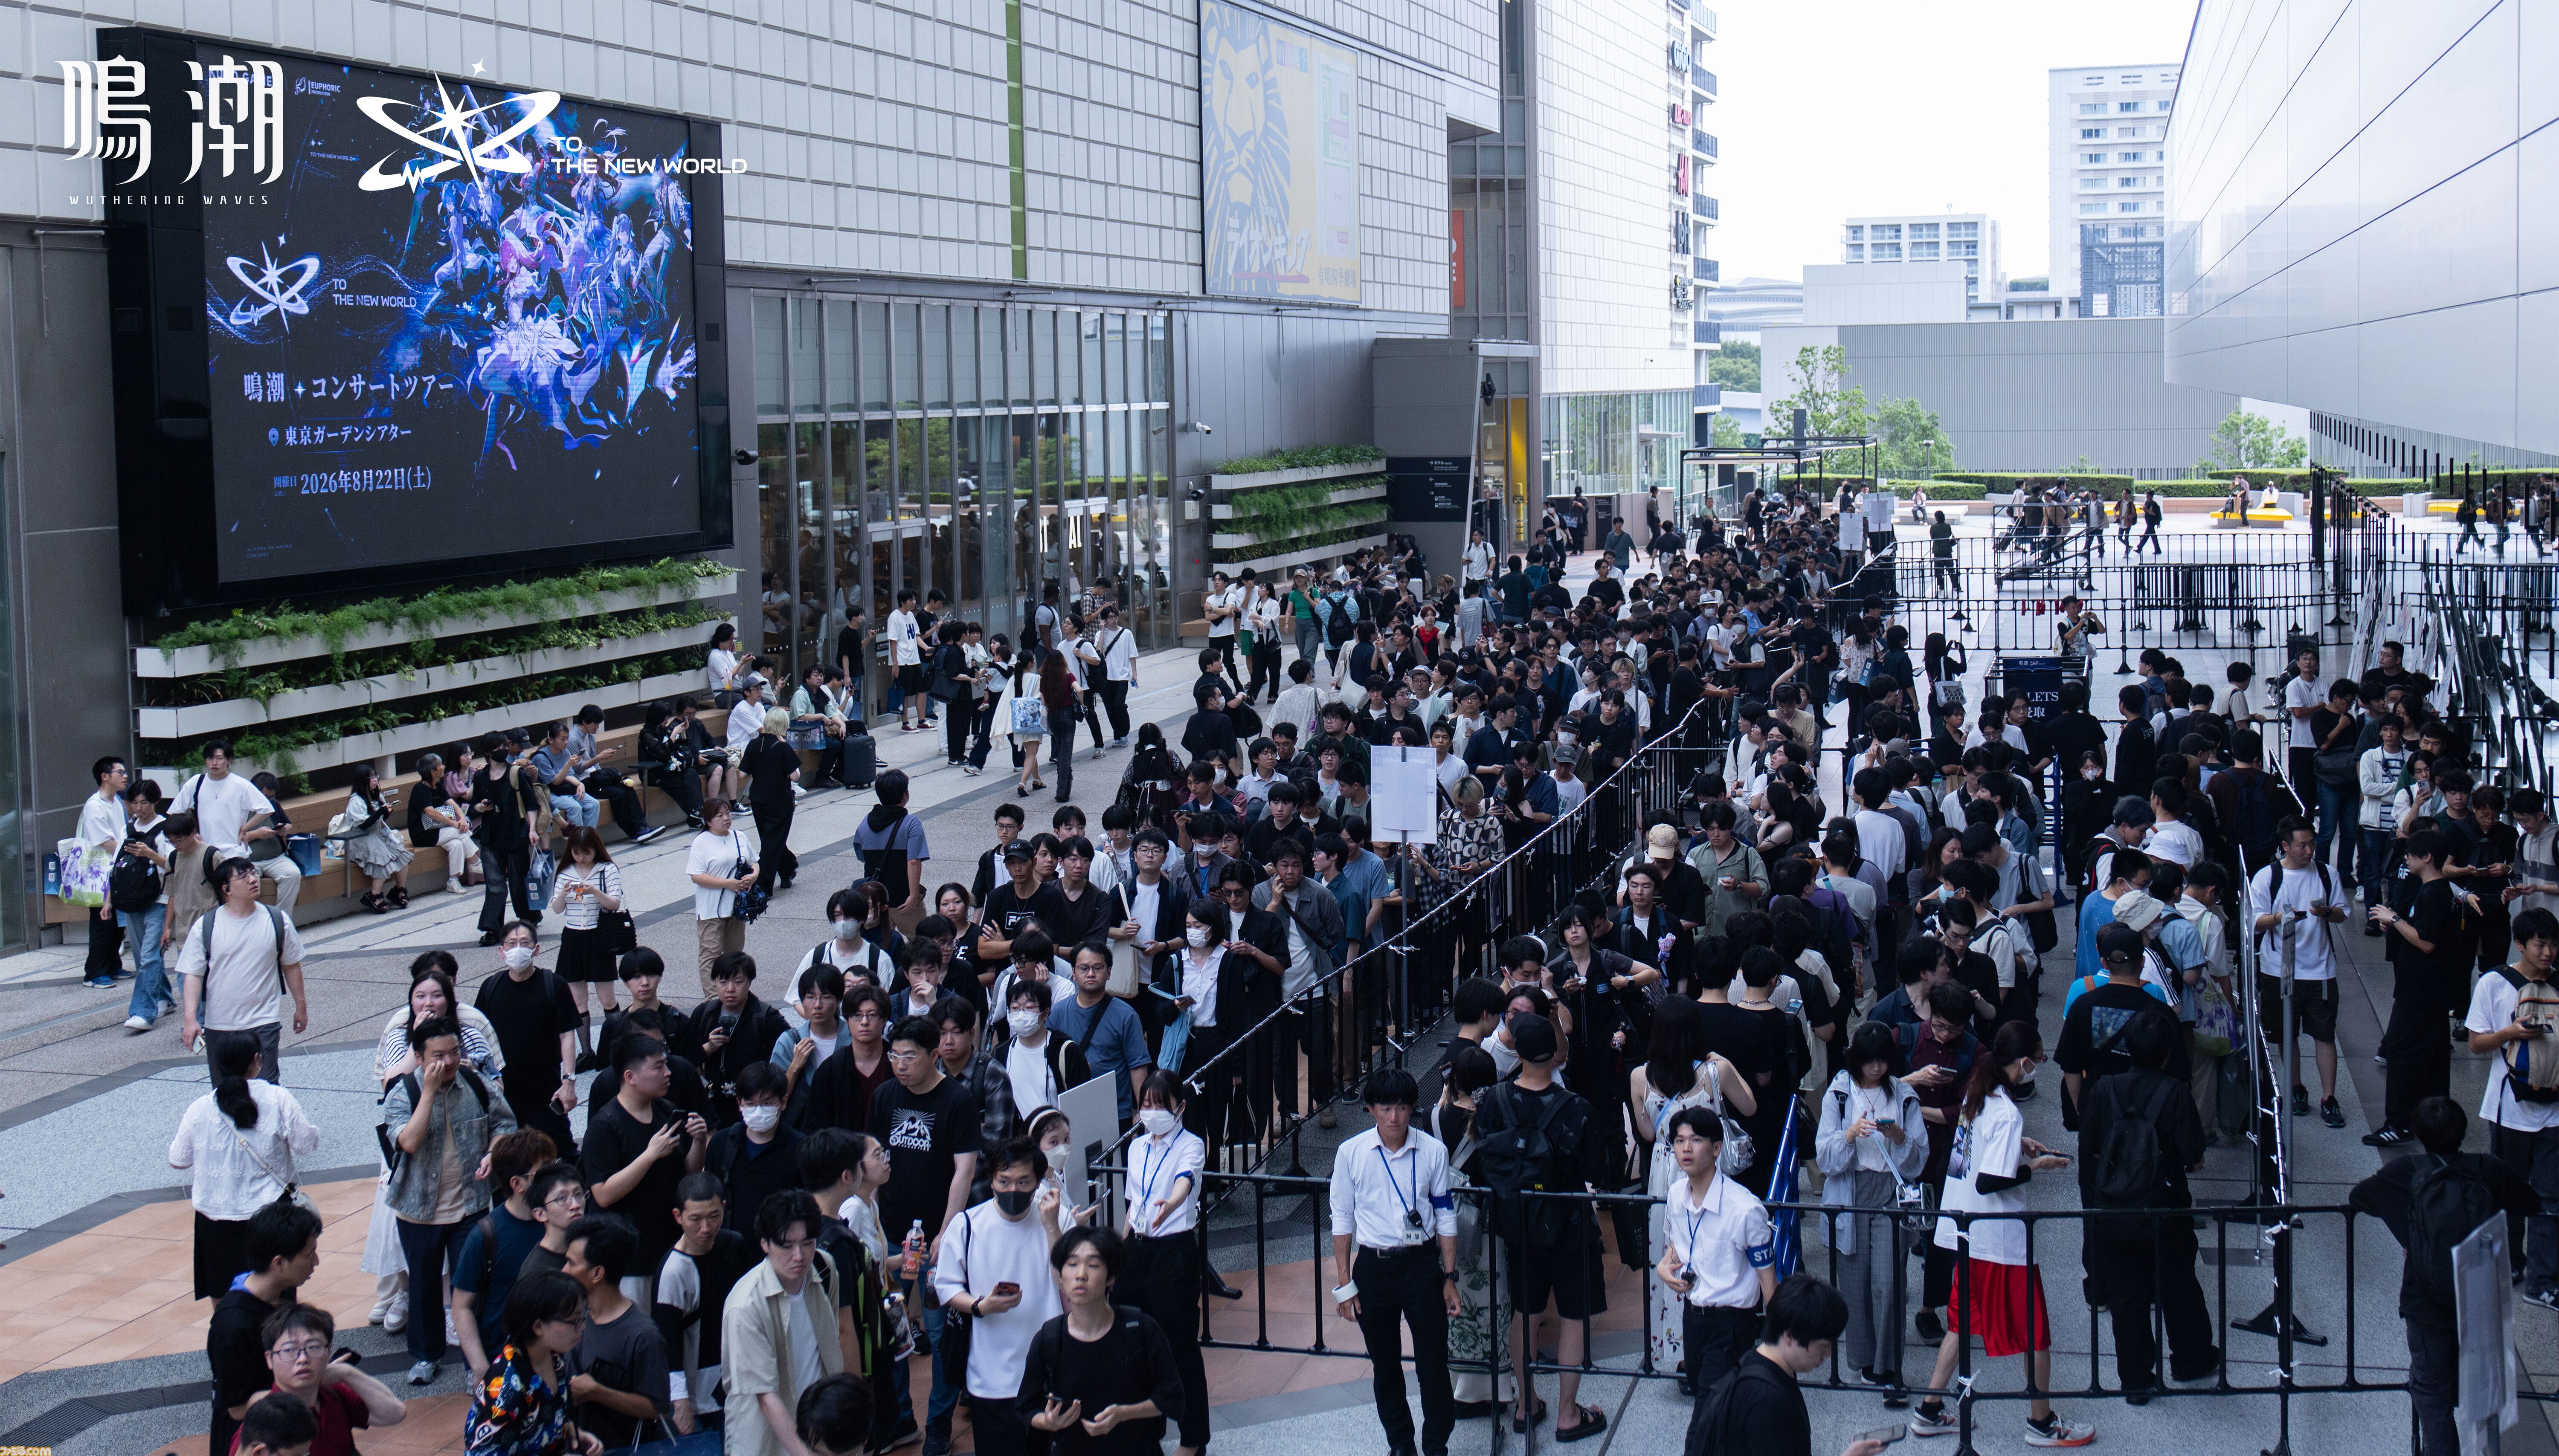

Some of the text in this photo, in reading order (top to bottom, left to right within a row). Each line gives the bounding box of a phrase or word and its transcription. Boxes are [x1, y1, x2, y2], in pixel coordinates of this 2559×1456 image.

[311, 81, 341, 93] EUPHORIC
[1226, 217, 1311, 276] ライオンキング
[333, 278, 347, 290] TO
[332, 294, 417, 308] THE NEW WORLD
[244, 371, 454, 403] 鳴潮 コンサートツアー
[285, 425, 412, 446] 東京ガーデンシアター
[301, 466, 432, 495] 2026年8月22日(土)
[2027, 691, 2059, 702] LETS
[889, 1135, 930, 1151] OUTDOOR
